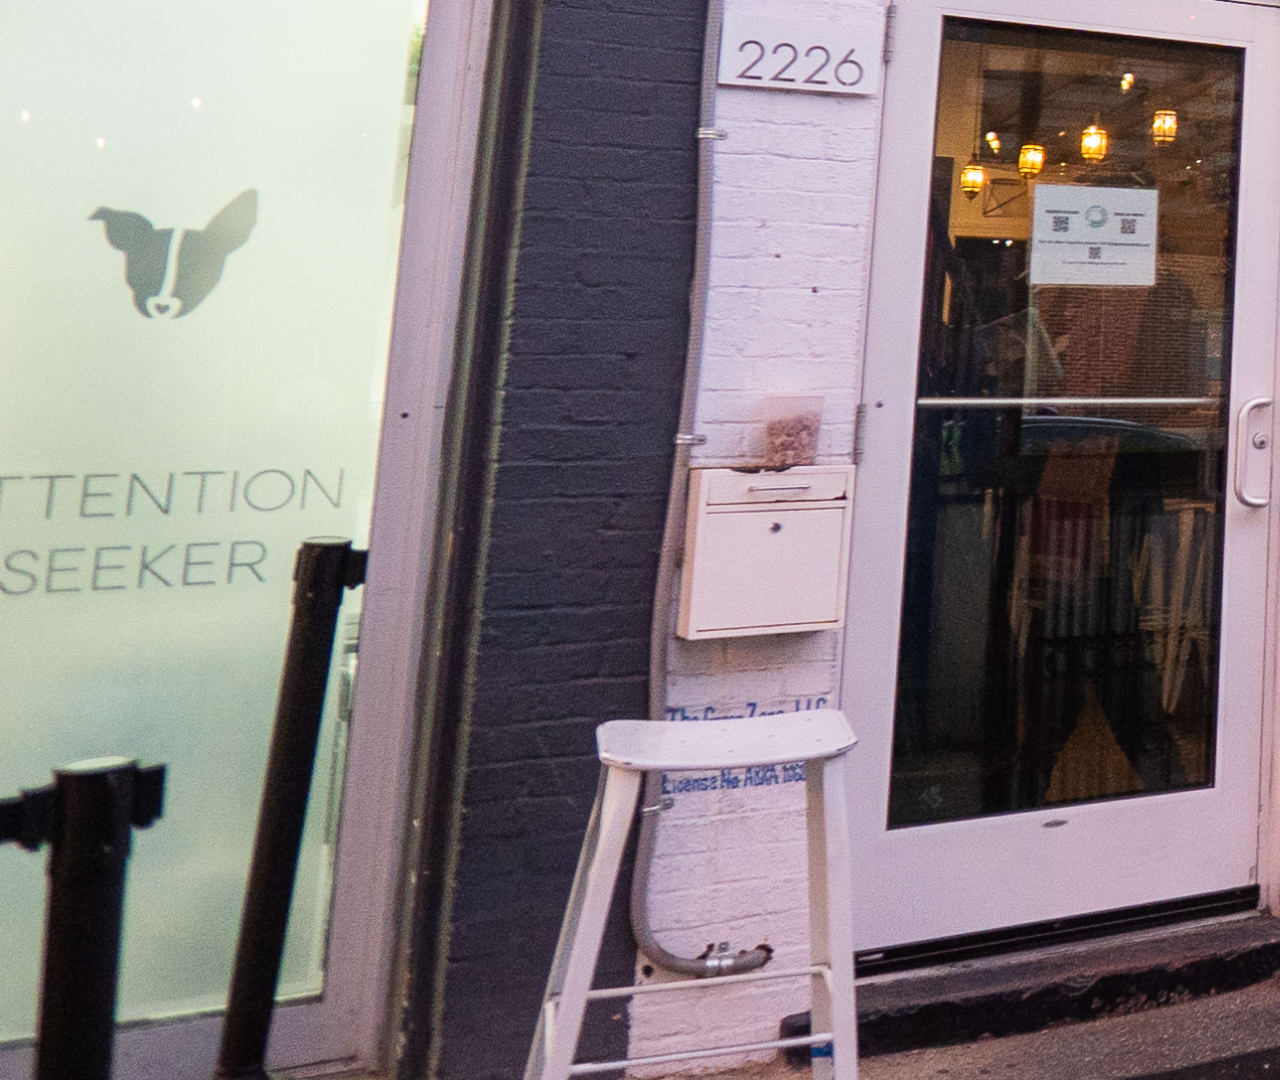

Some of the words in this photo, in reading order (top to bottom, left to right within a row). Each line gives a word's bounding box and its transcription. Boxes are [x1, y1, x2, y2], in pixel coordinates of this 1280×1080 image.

[736, 40, 864, 87] 2226
[0, 469, 344, 521] TTENTION
[0, 540, 268, 596] SEEKER
